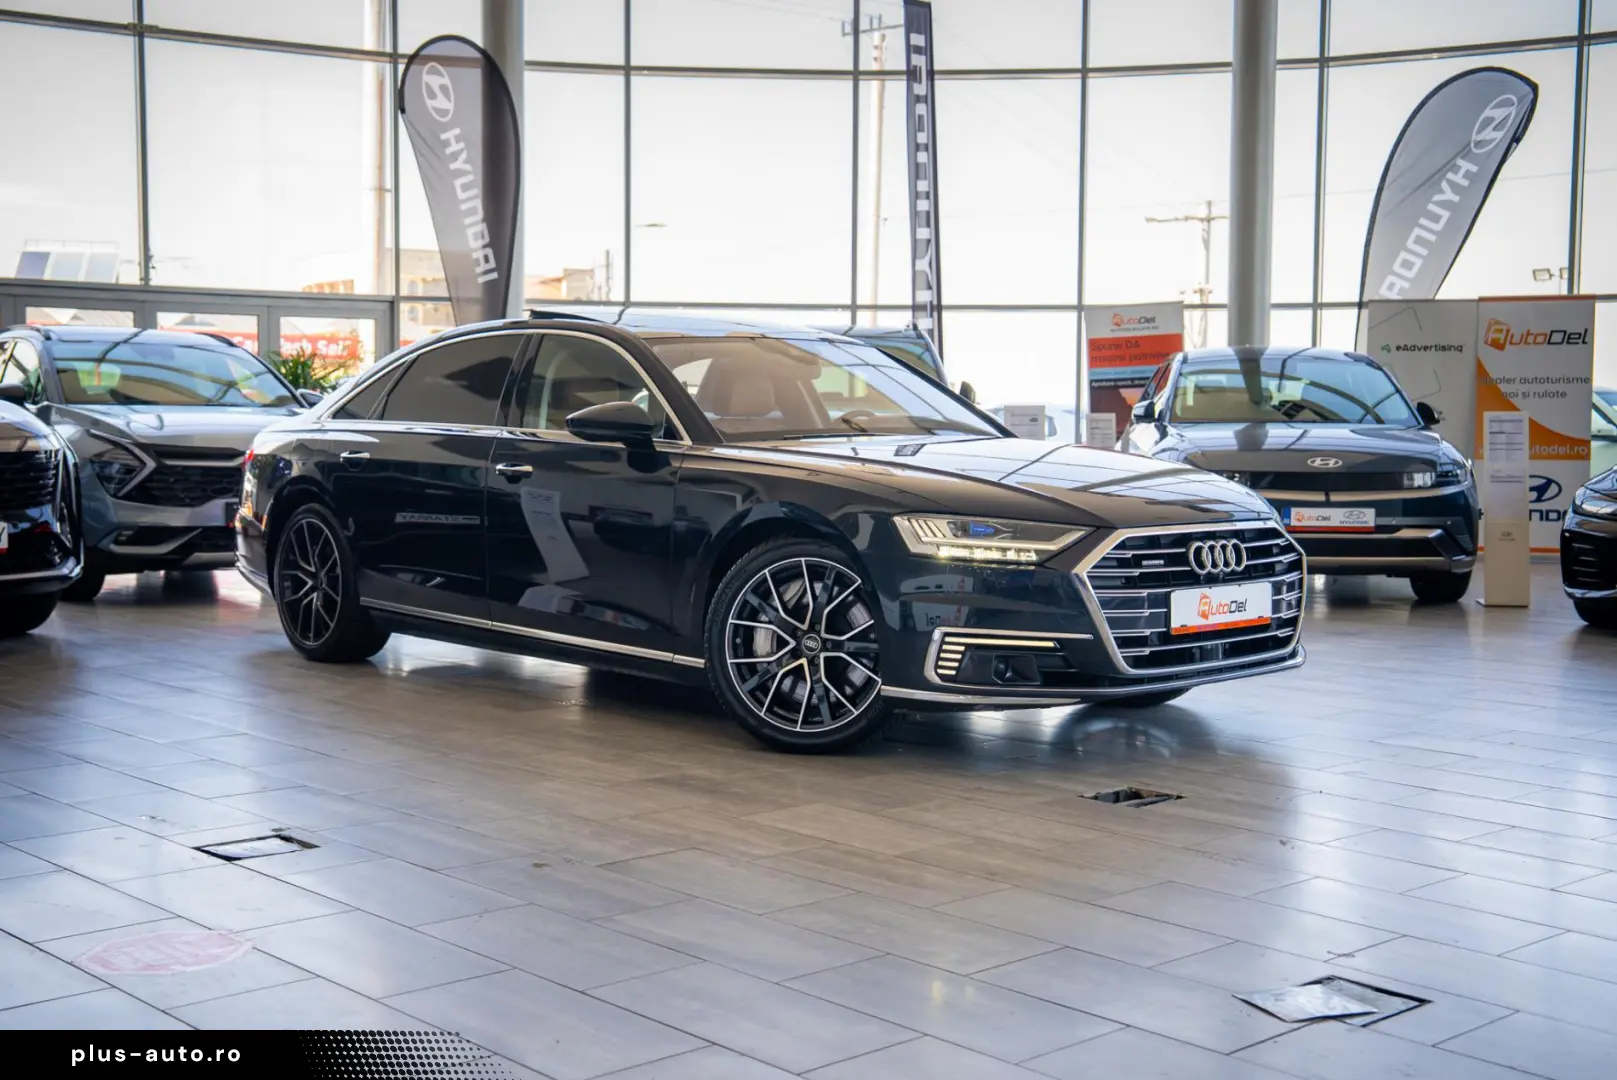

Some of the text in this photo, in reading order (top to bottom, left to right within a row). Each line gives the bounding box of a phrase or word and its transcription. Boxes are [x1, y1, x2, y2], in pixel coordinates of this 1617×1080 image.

[440, 128, 498, 283] HYUNDAI
[1485, 319, 1588, 350] AutoDel
[1125, 339, 1141, 350] DA
[1396, 343, 1464, 354] eAdvertising
[1519, 375, 1590, 385] autoturisme
[1533, 389, 1567, 399] rulate
[1197, 593, 1247, 620] AutoDel
